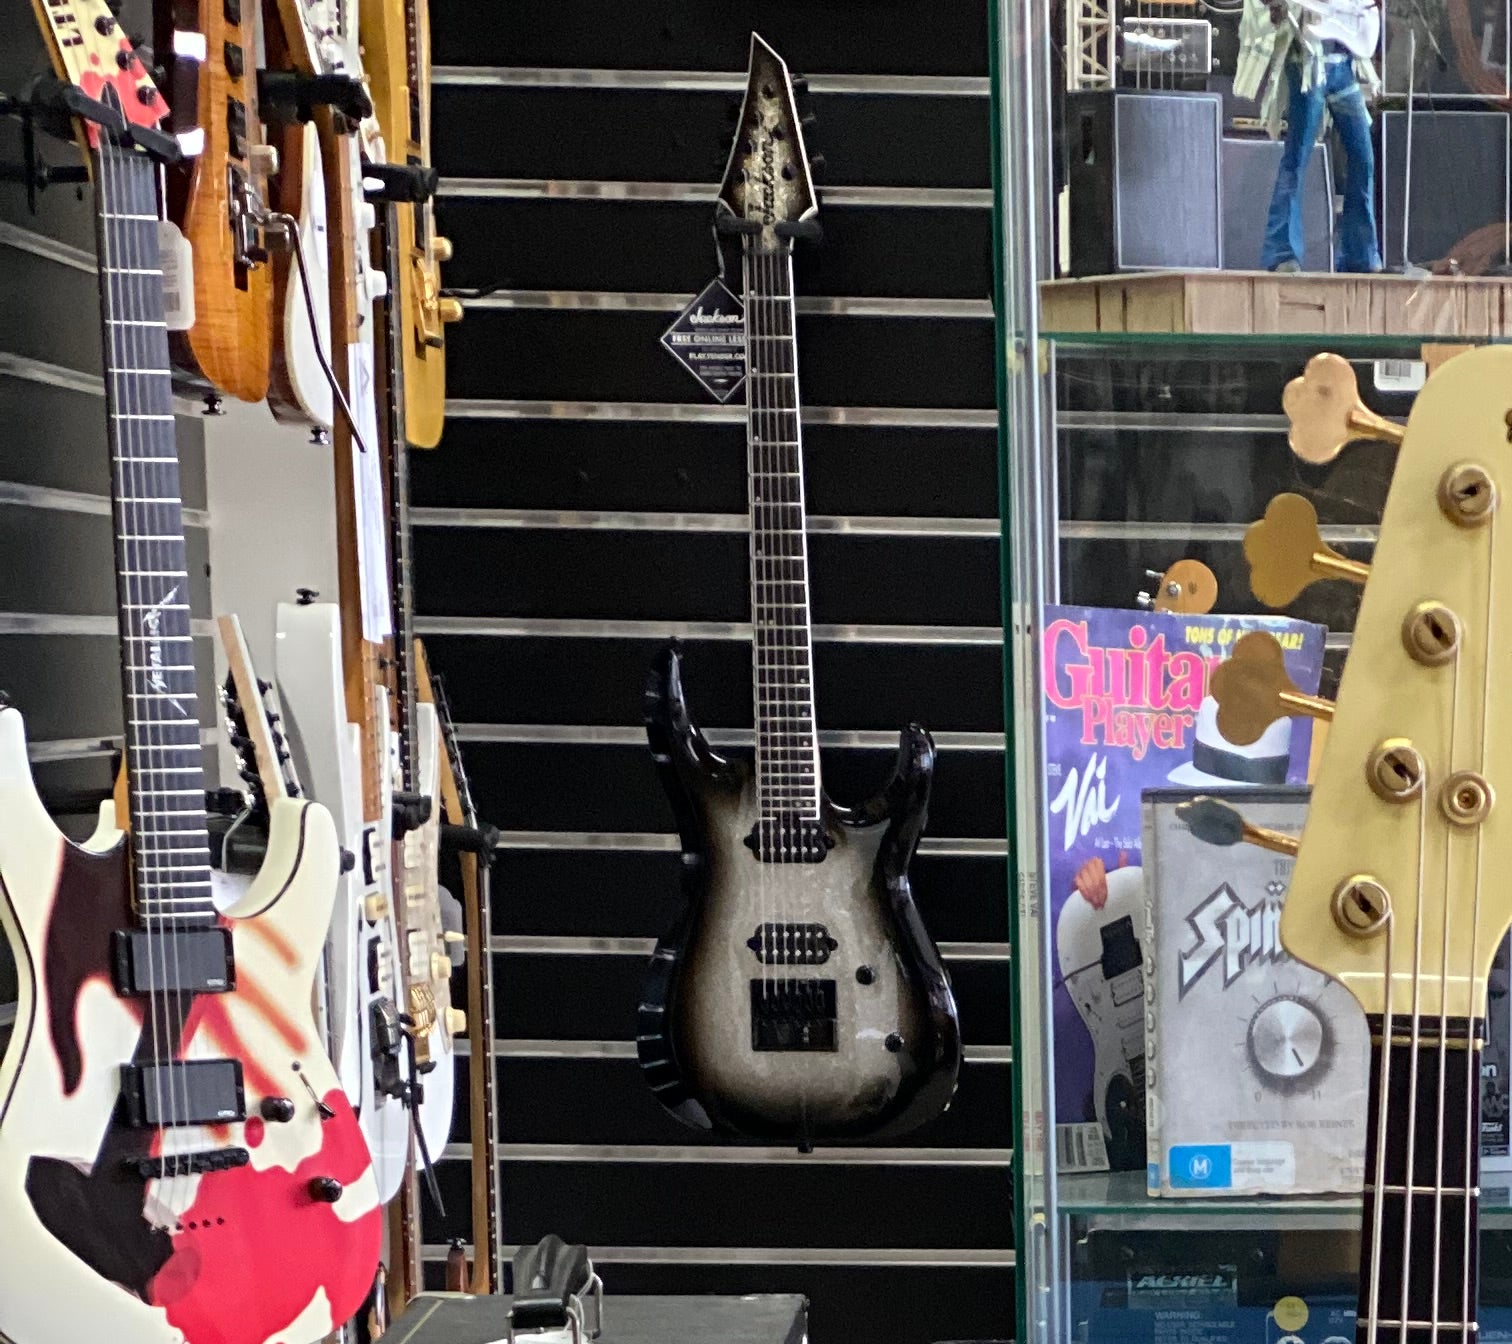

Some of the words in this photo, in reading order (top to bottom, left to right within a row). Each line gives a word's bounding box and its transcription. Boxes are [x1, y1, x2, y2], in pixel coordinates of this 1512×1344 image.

[1080, 694, 1192, 761] Player
[1050, 752, 1121, 851] Vai
[1192, 1160, 1208, 1175] M
